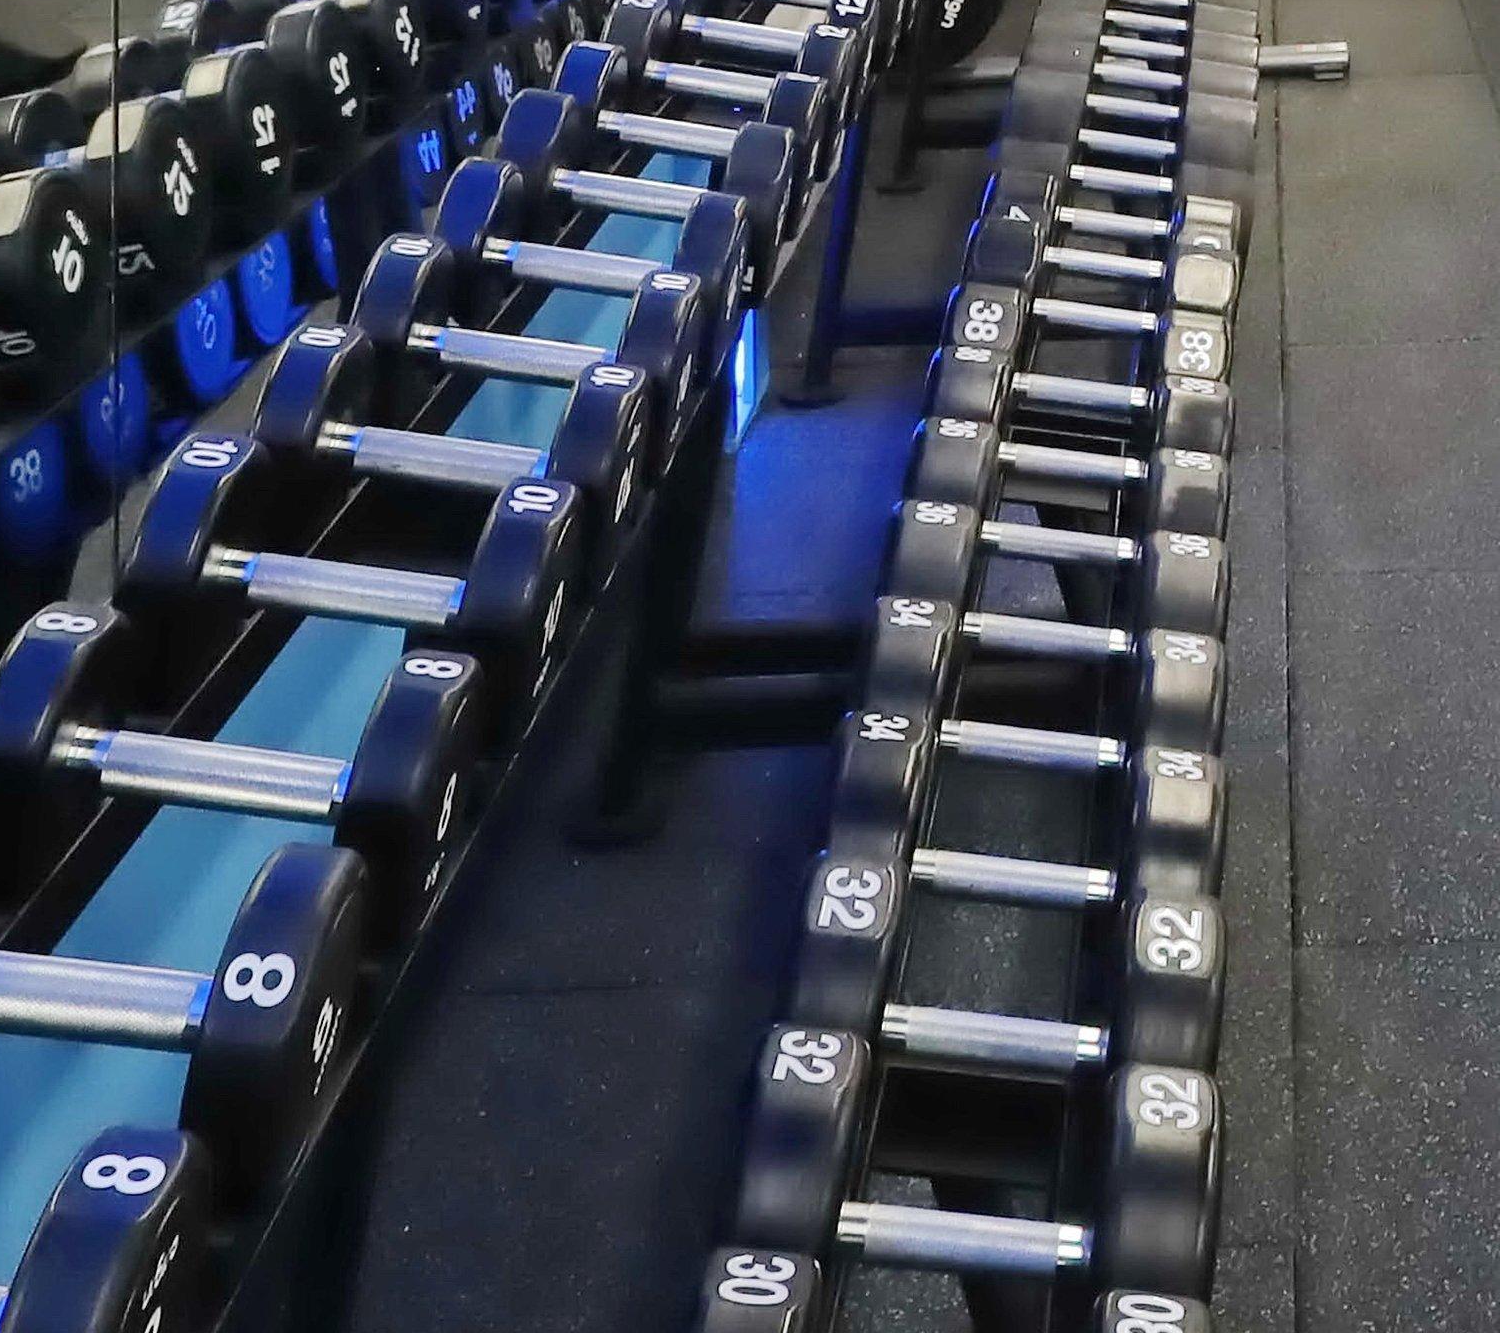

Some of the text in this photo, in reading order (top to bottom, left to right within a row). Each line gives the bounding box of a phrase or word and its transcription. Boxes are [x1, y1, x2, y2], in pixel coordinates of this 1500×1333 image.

[389, 236, 435, 257] 10
[650, 273, 692, 291] 10
[964, 299, 1004, 342] 38
[298, 325, 348, 349] 10
[1178, 331, 1213, 372] 38
[590, 366, 637, 387] 10
[183, 439, 239, 469] 10
[1174, 448, 1213, 471] 36
[508, 484, 562, 513] 10
[913, 500, 958, 528] 36
[1169, 533, 1210, 560] 36
[35, 611, 98, 634] 8
[890, 597, 936, 629] 34
[1164, 632, 1209, 665] 34
[404, 657, 464, 680] 8
[859, 712, 911, 743] 34
[1156, 748, 1203, 781] 34
[817, 866, 883, 931] 32
[1146, 906, 1203, 972] 32
[222, 950, 297, 1008] 8
[771, 1029, 843, 1085] 32
[1137, 1074, 1200, 1129] 32
[82, 1153, 167, 1196] 8
[717, 1252, 797, 1307] 30
